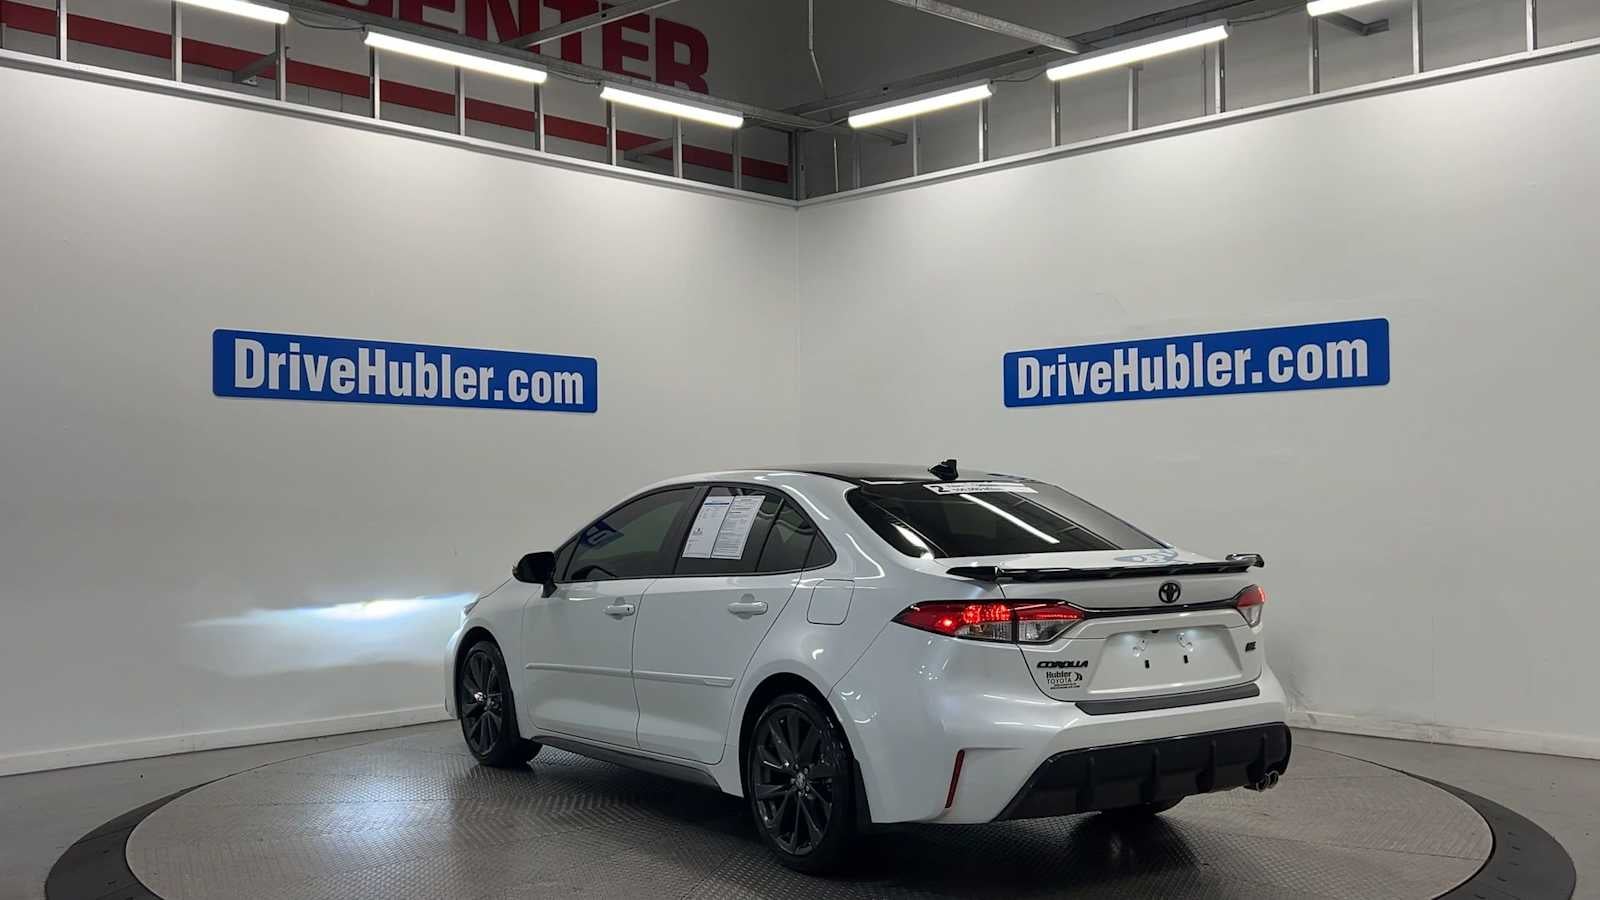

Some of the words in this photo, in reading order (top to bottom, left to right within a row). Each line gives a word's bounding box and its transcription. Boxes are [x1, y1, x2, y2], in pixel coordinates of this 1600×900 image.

[319, 0, 710, 95] ENTER
[233, 337, 585, 405] DriveHubler.com
[1017, 337, 1369, 400] DriveHubler.com
[1036, 660, 1089, 669] COROLLA
[1046, 670, 1072, 678] Hubler
